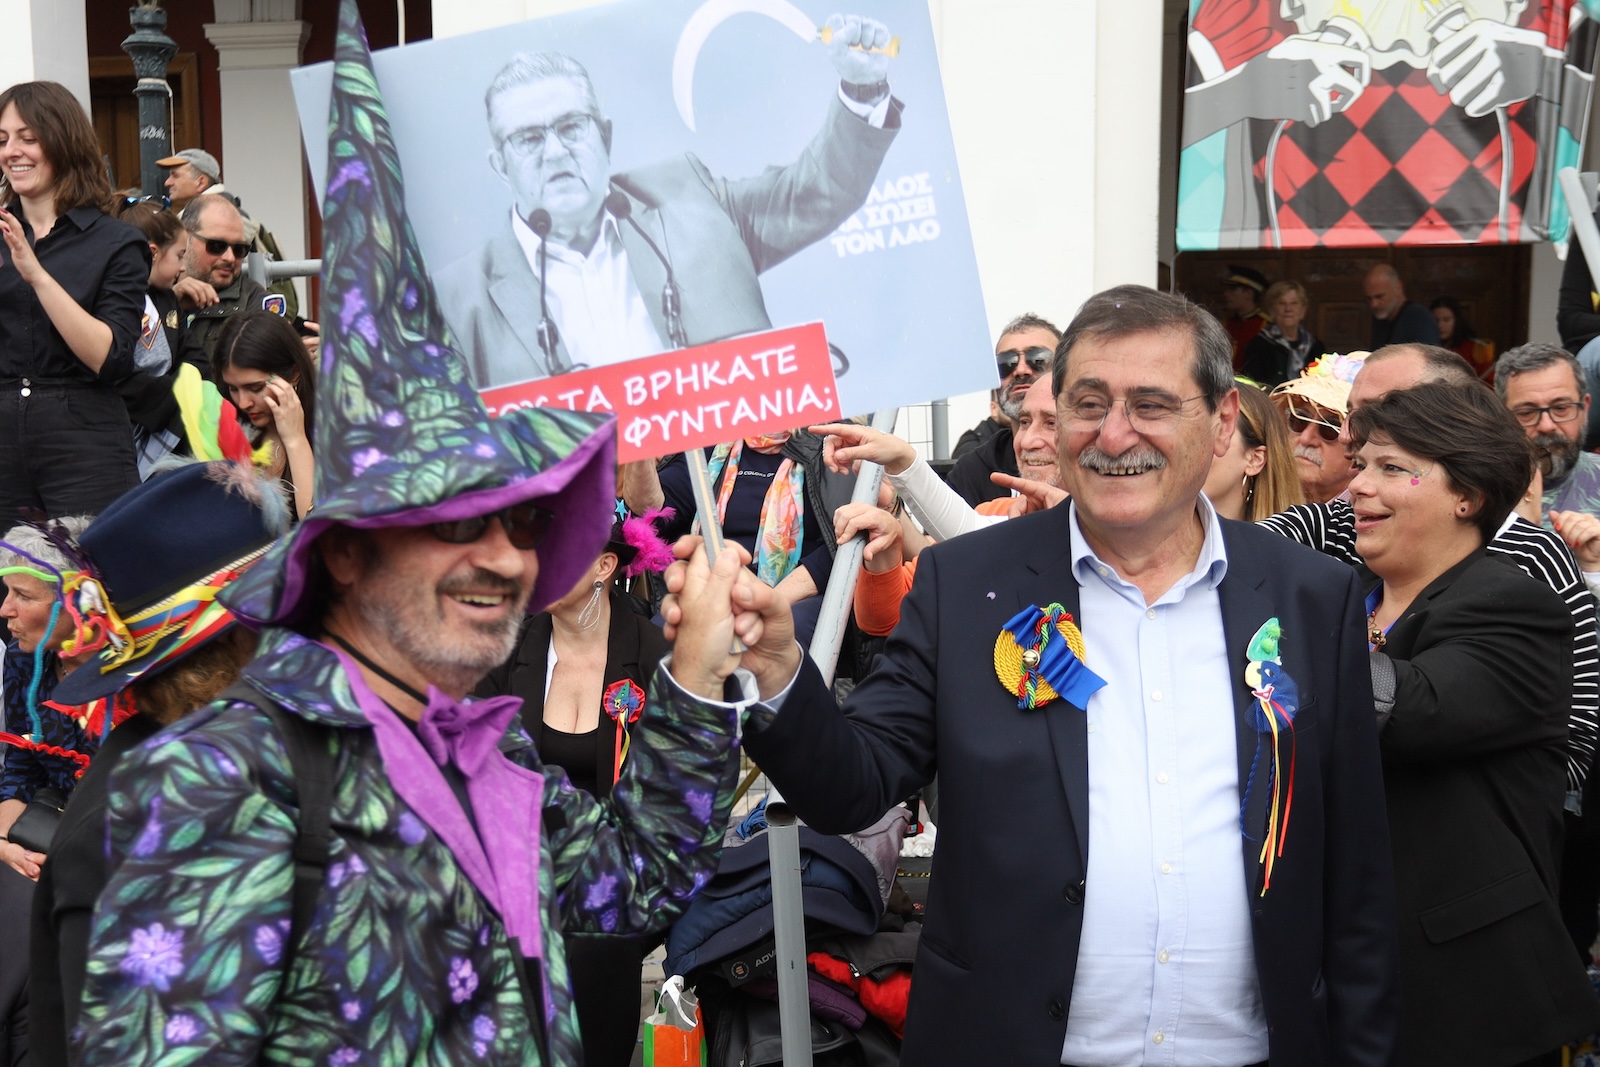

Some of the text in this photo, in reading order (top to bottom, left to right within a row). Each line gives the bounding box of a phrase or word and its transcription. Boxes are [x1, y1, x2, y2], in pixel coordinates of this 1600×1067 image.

[864, 195, 936, 228] ΣΩΣΕΙ
[830, 218, 941, 258] ΤΟΝ ΛΑΟ
[557, 384, 613, 413] ΤΑ
[623, 344, 798, 406] ΒΡΗΚΑΤΕ
[624, 383, 833, 448] ΦΥΝΤΑΝΙΑ;
[755, 950, 775, 967] ADV
